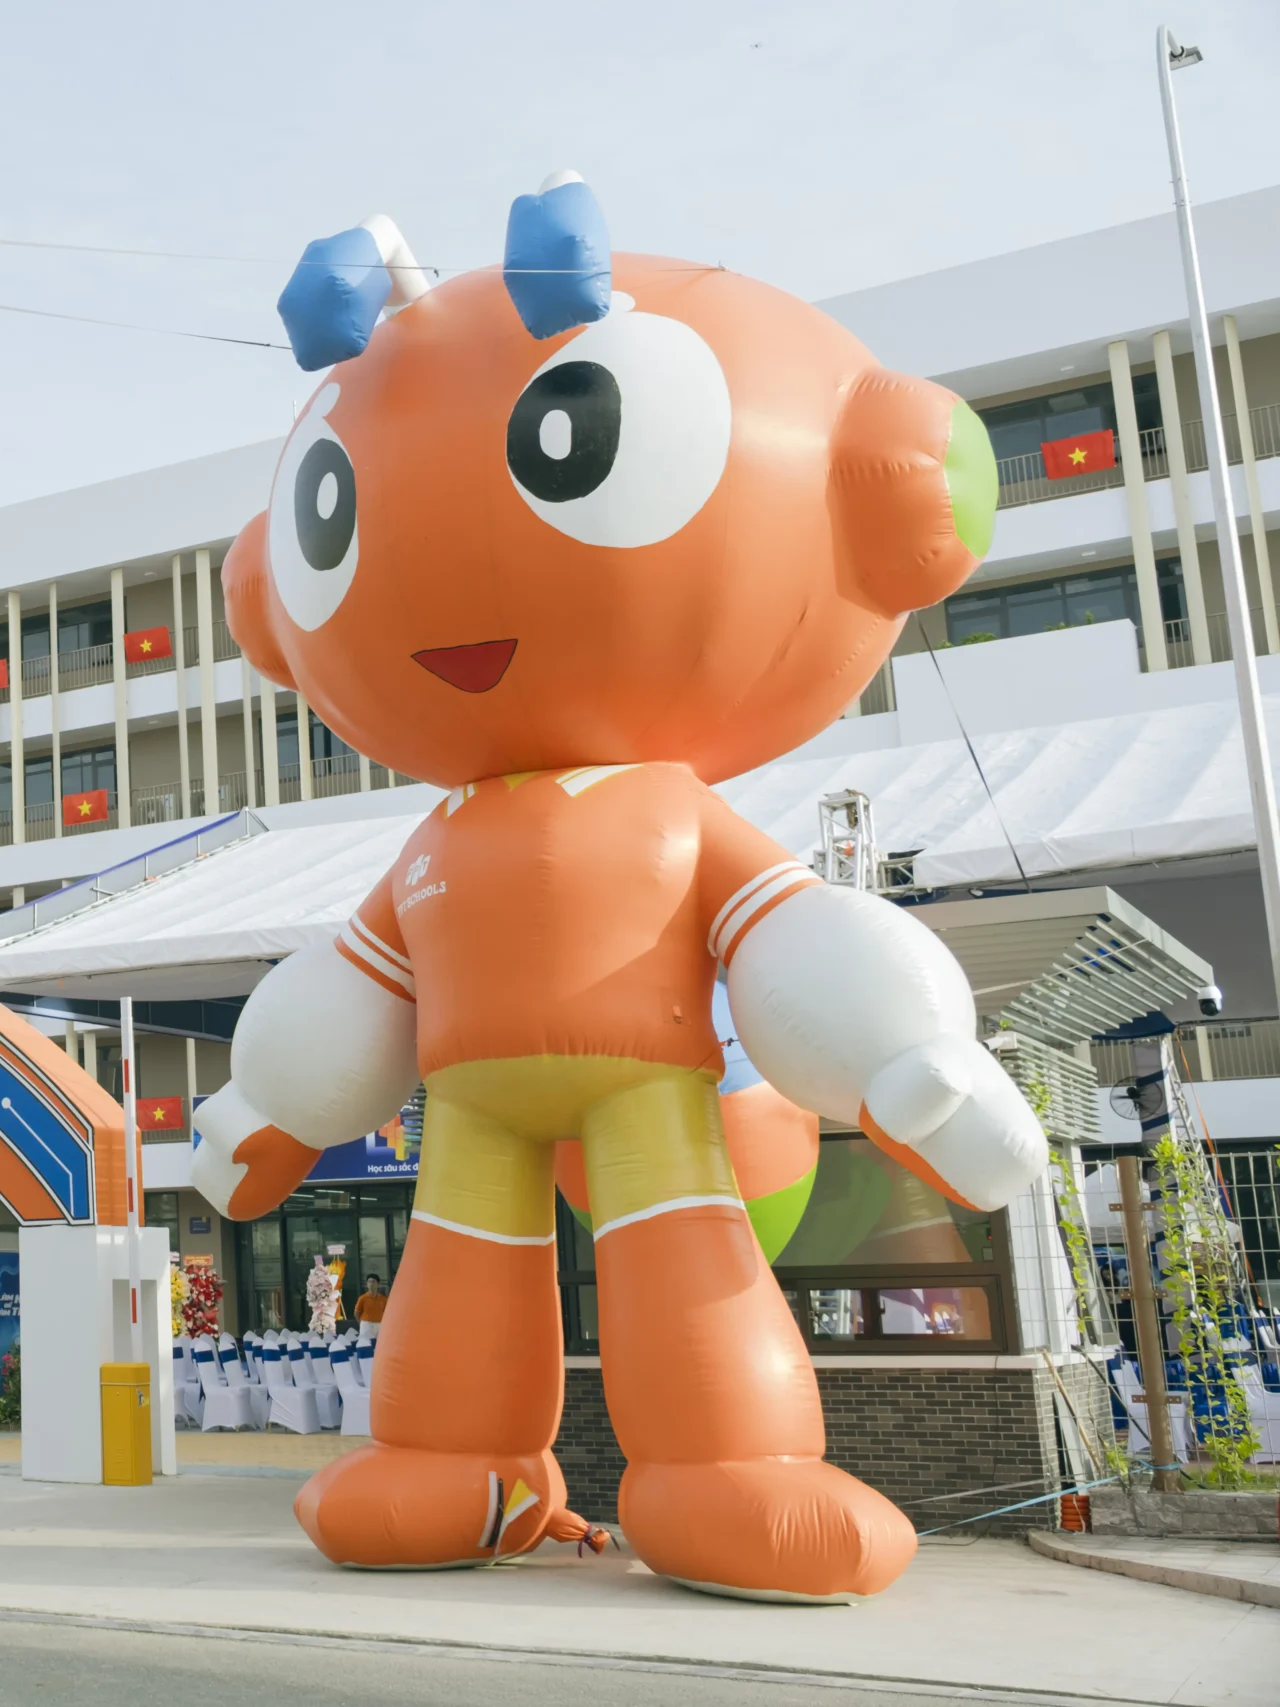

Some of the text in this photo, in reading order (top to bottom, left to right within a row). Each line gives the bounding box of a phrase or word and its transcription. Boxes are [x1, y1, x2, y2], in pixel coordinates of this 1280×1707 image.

[407, 881, 446, 908] SCHOOLS
[367, 1164, 383, 1174] Học
[384, 1164, 397, 1172] sâu
